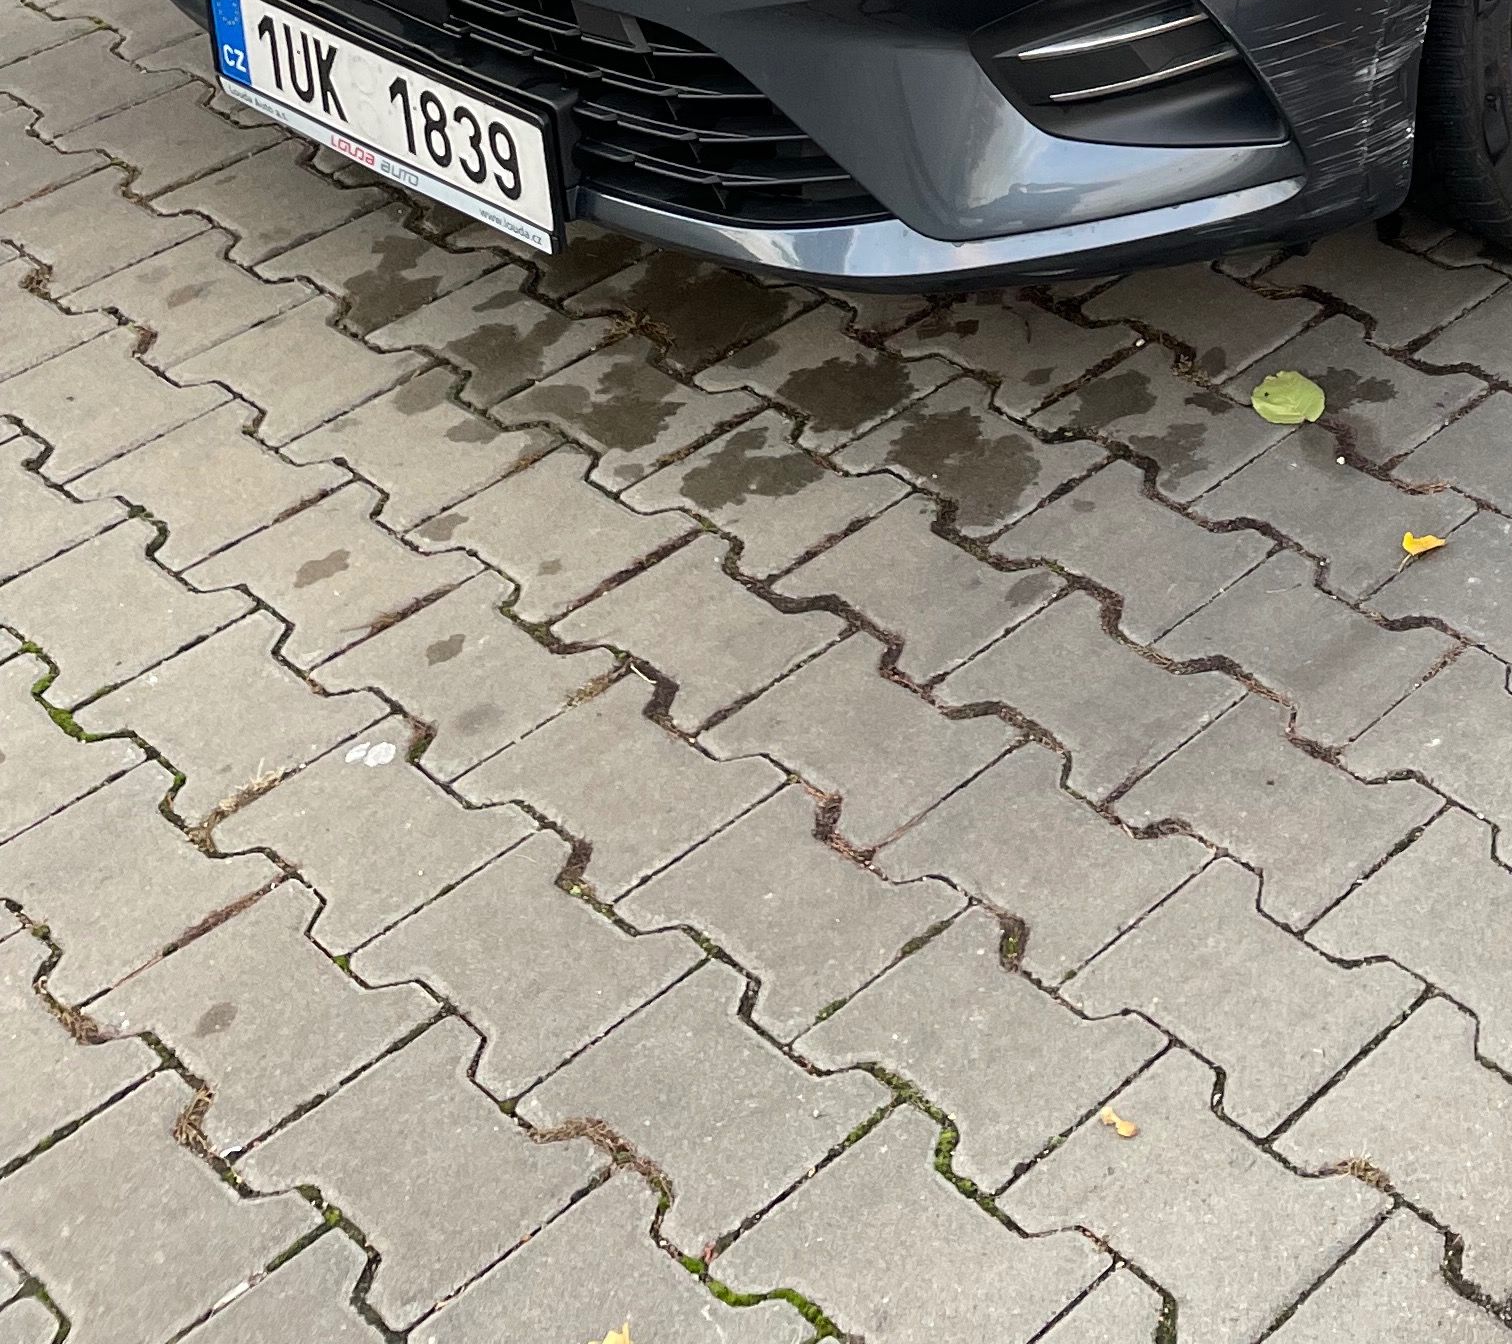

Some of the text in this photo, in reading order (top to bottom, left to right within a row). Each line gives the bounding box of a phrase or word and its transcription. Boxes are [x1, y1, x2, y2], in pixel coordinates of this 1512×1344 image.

[223, 44, 247, 72] CZ
[258, 14, 522, 200] 1UK 1839
